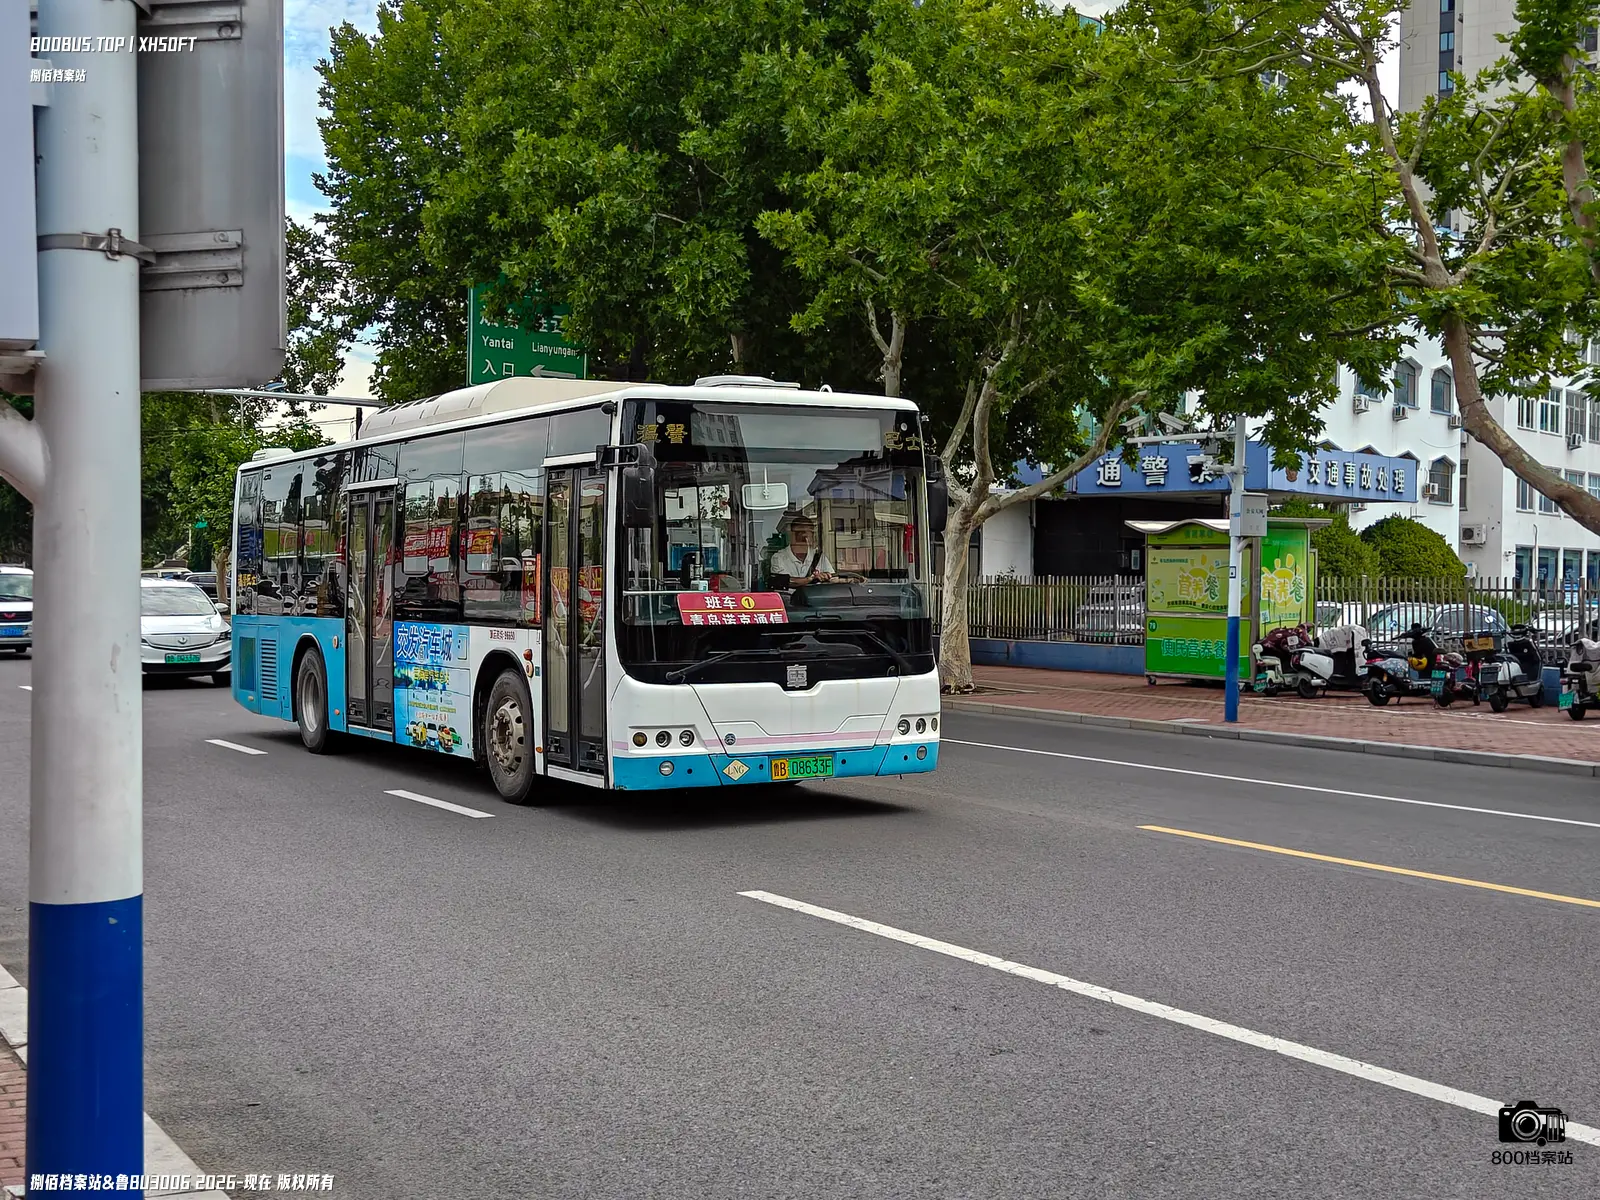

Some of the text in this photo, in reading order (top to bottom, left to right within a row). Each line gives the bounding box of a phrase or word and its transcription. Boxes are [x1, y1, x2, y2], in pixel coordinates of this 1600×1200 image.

[482, 335, 514, 349] Yantai
[482, 358, 514, 376] 入口
[637, 424, 921, 450] 温馨 巴士
[1309, 458, 1405, 493] 交通事故处理
[1179, 573, 1219, 600] 营养餐
[1261, 573, 1305, 604] 营养餐
[704, 596, 738, 609] 班车
[690, 613, 783, 626] 青岛诺克通信
[397, 623, 453, 661] 交发汽车城
[1161, 636, 1228, 660] 便民营养餐
[727, 764, 745, 775] LNG
[791, 759, 831, 775] 08633F
